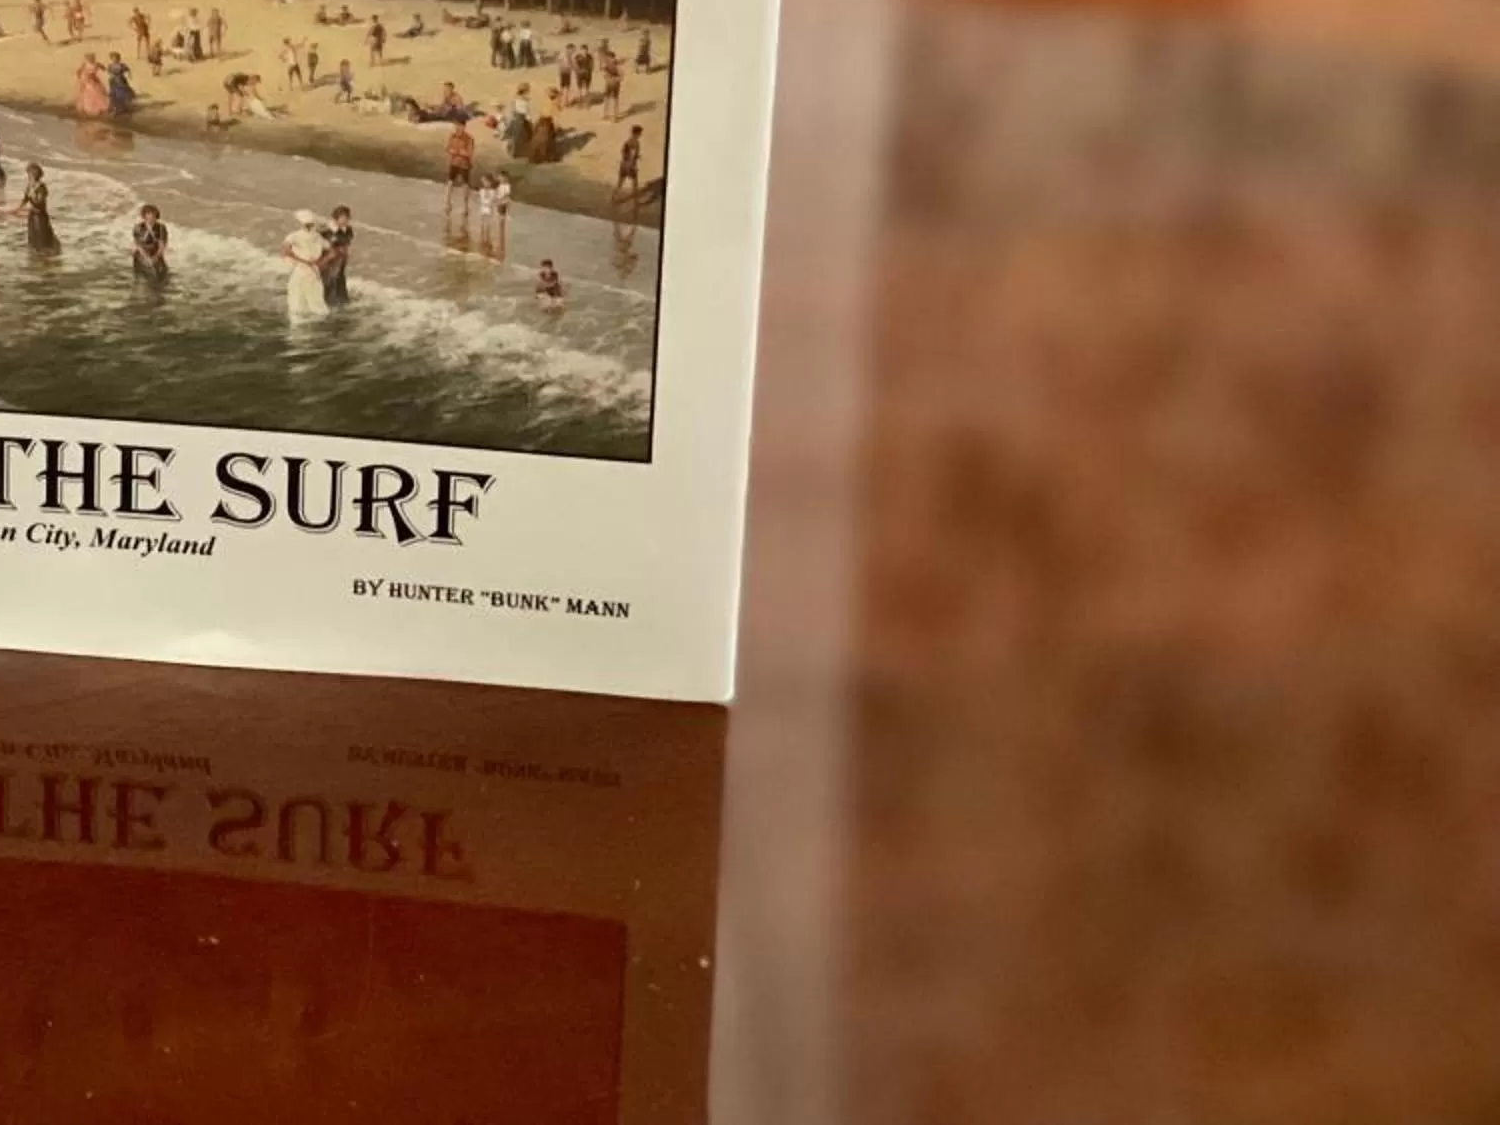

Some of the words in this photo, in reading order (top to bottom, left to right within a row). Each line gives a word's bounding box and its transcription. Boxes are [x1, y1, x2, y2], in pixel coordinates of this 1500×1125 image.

[212, 452, 496, 546] SURF
[26, 523, 81, 551] City,
[91, 527, 216, 557] Maryland
[352, 578, 384, 597] BY
[388, 582, 475, 605] HUNTER
[480, 591, 560, 612] "BUNK"
[566, 598, 631, 618] MANN
